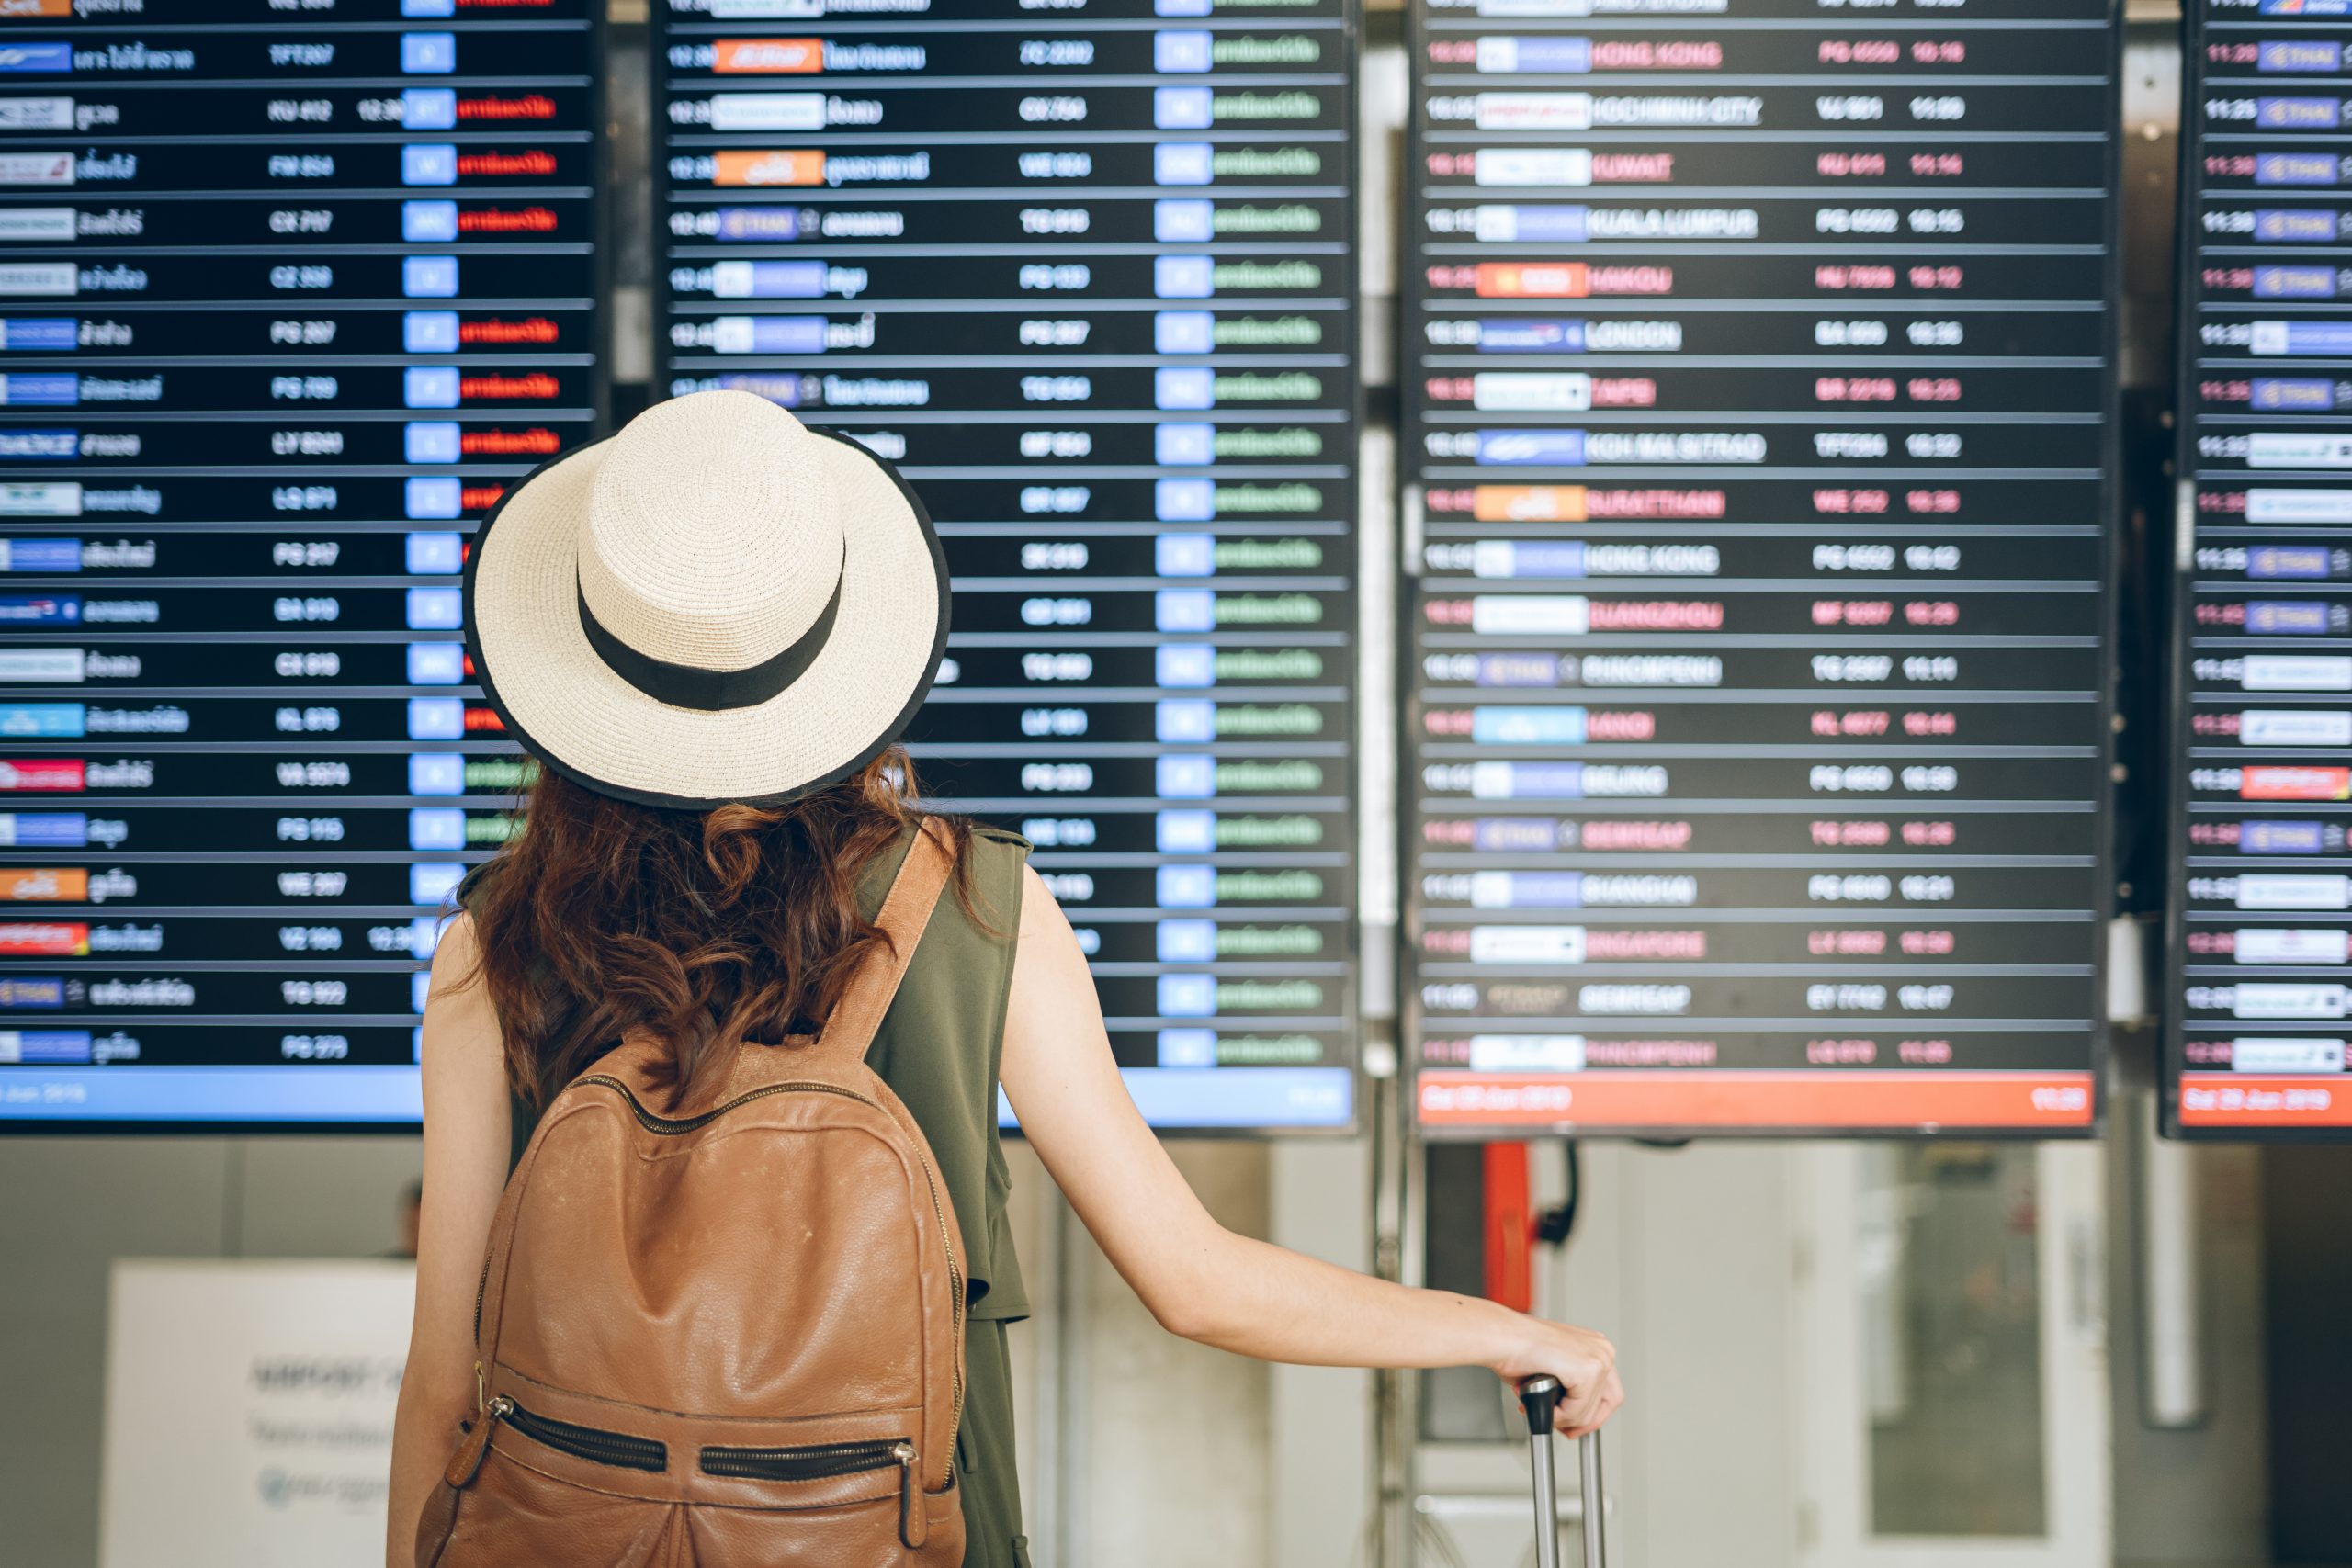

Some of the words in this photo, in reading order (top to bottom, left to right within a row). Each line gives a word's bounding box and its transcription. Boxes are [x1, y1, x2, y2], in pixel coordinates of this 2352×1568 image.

[1657, 42, 1722, 68] KONG
[1709, 97, 1761, 125] CITY
[1590, 154, 1672, 180] KUWAIT
[1585, 321, 1681, 351] LONDON
